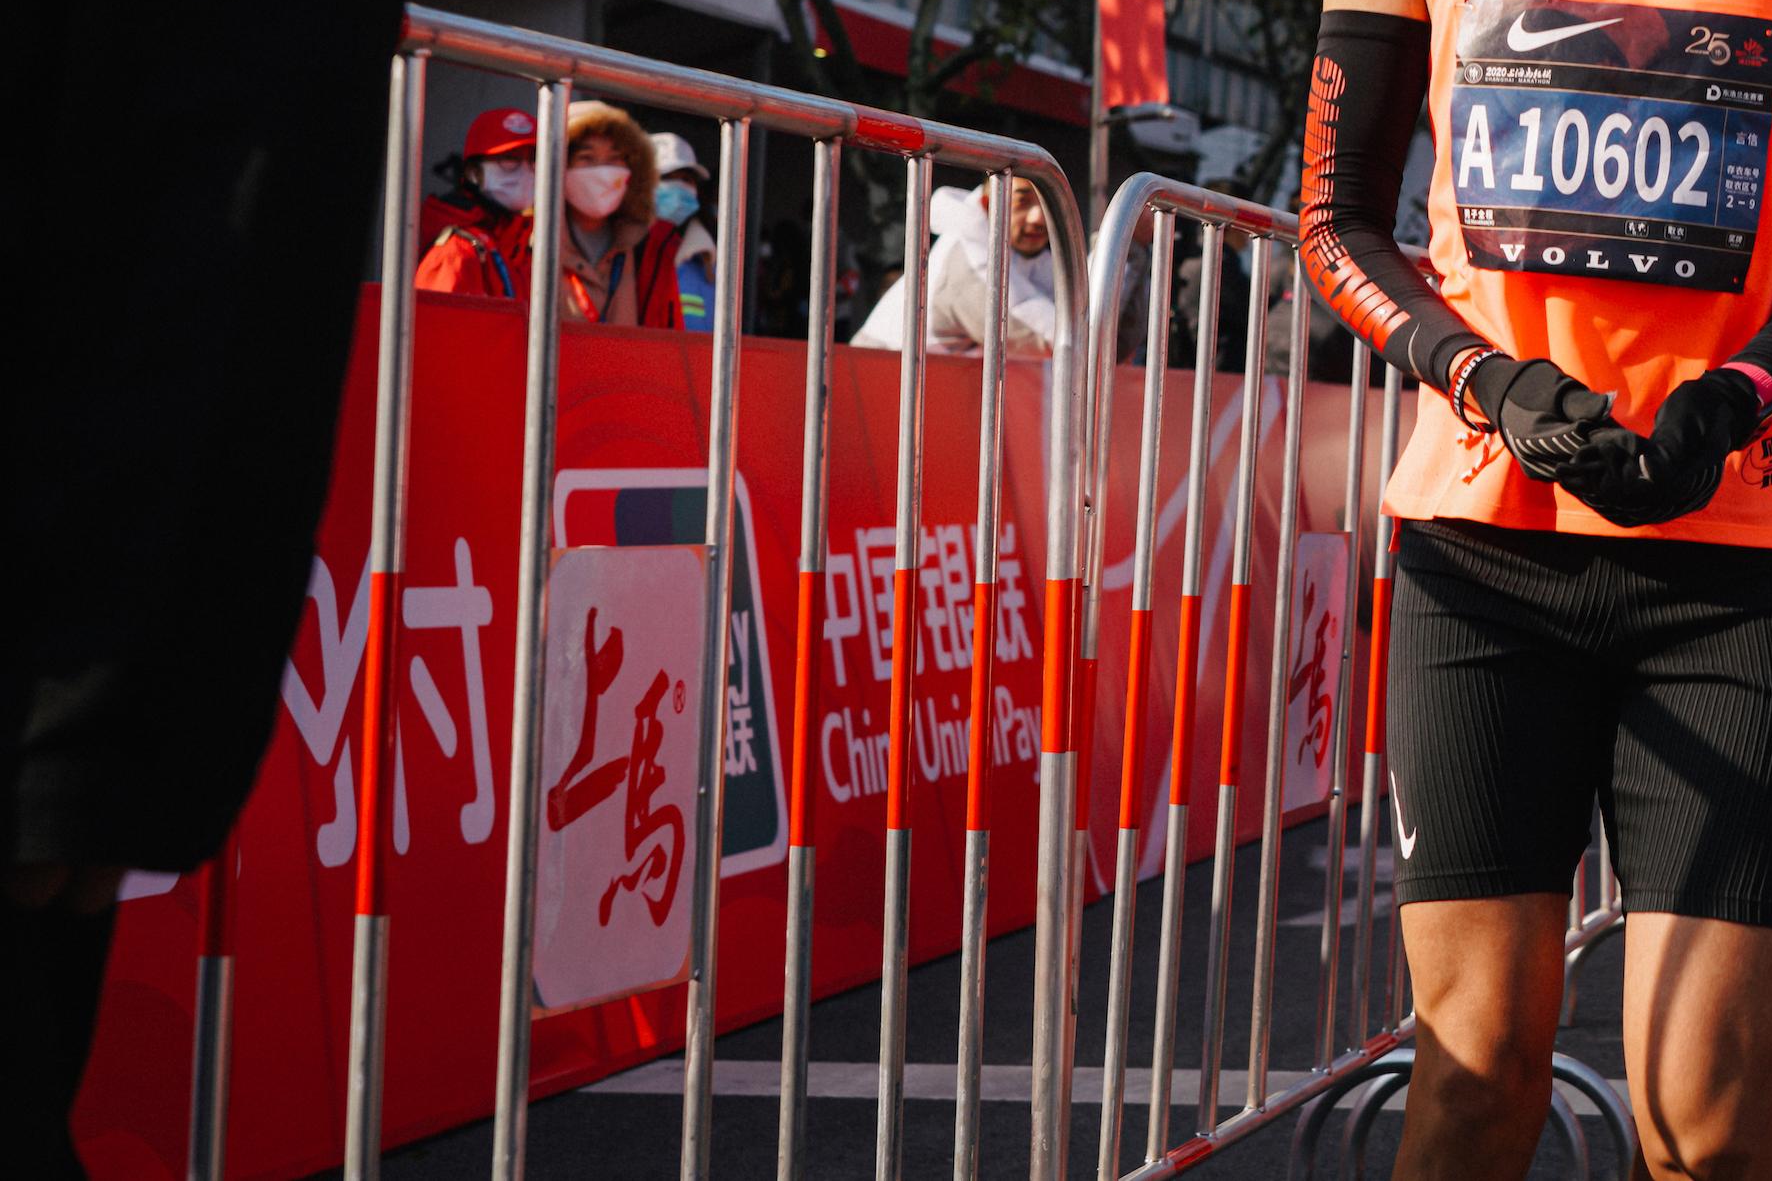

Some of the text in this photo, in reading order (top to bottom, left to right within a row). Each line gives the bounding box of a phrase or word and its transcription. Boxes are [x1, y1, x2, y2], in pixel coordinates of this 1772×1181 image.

[1684, 25, 1731, 67] 25
[1500, 243, 1696, 279] VOLVO
[821, 706, 890, 803] Chin
